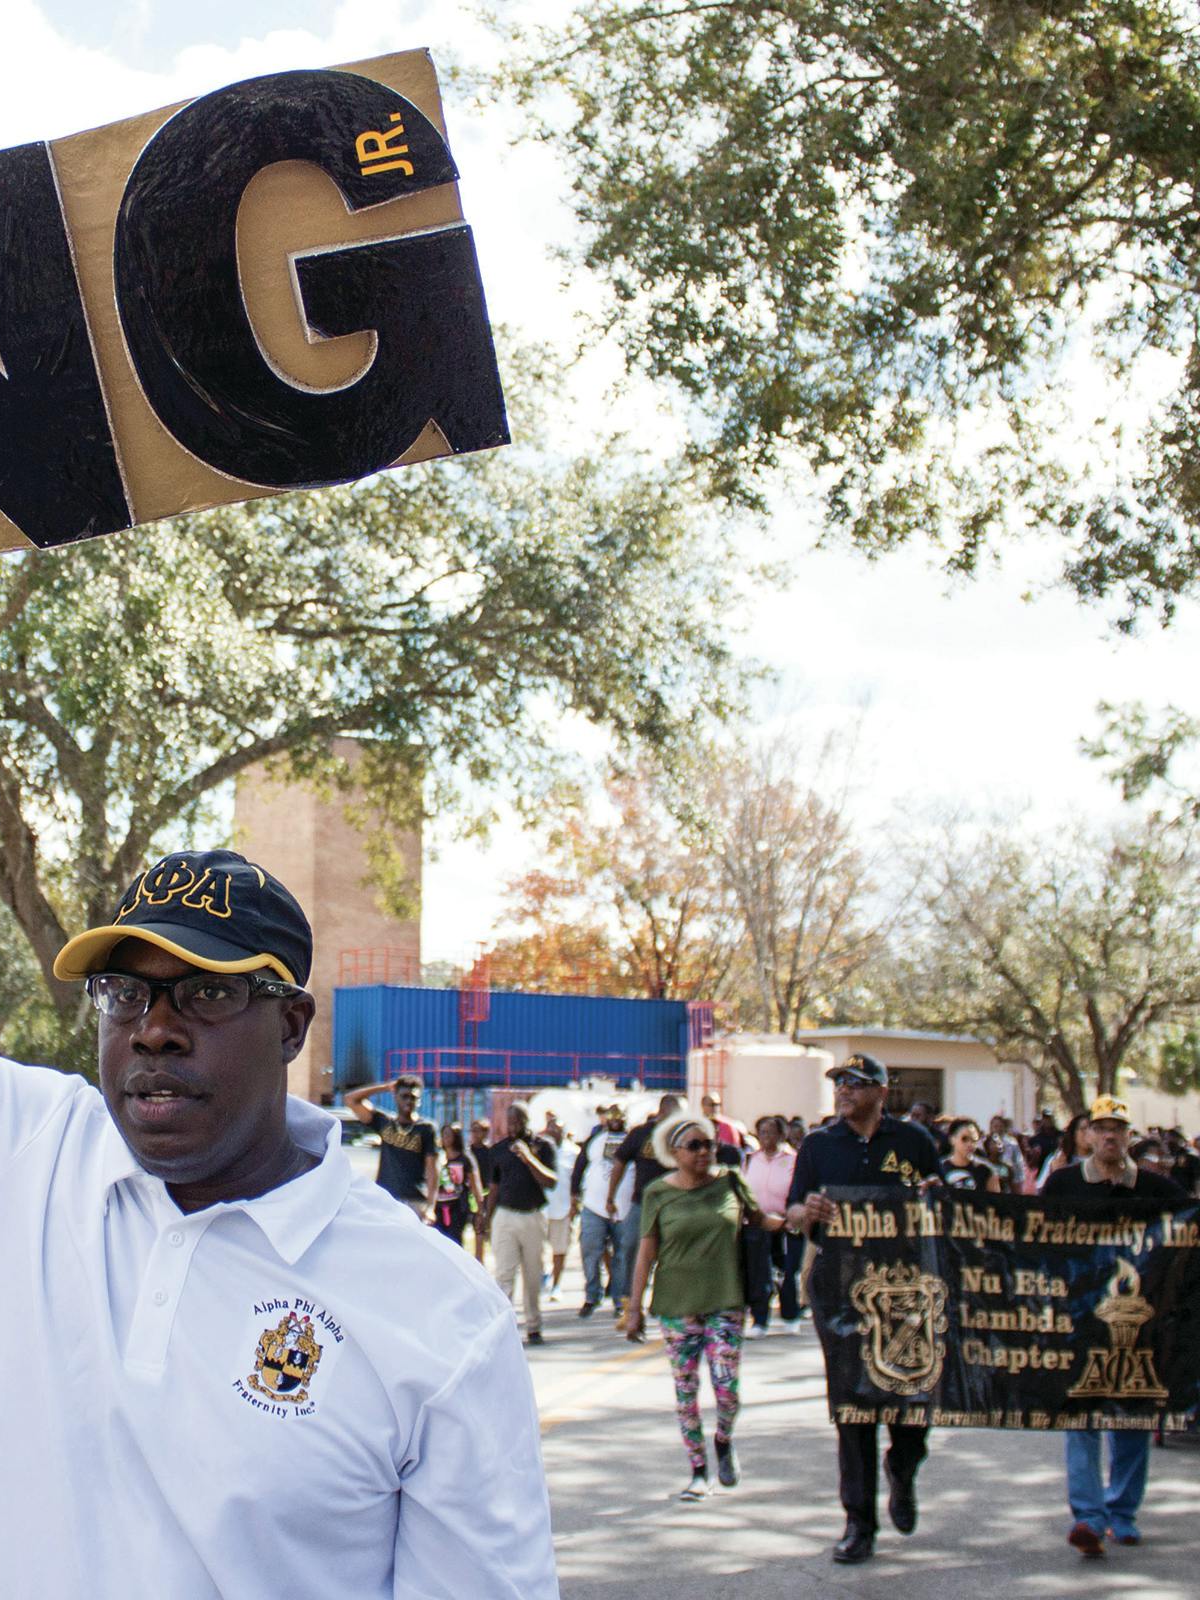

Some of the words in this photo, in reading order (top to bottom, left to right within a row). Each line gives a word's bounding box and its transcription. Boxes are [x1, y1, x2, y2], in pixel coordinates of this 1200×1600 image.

[355, 112, 414, 176] JR.
[826, 1202, 898, 1247] Alpha
[905, 1201, 944, 1237] Phi
[951, 1203, 1015, 1248] Alpha
[1023, 1210, 1153, 1256] Fraternity,
[961, 1266, 1002, 1294] Nu
[1014, 1269, 1069, 1298] Eta
[253, 1298, 289, 1316] Alpha
[294, 1298, 315, 1314] Phi
[316, 1310, 344, 1344] Alpha
[960, 1304, 1075, 1334] Lambda
[962, 1338, 1075, 1374] Chapter
[232, 1379, 288, 1419] Fraternity
